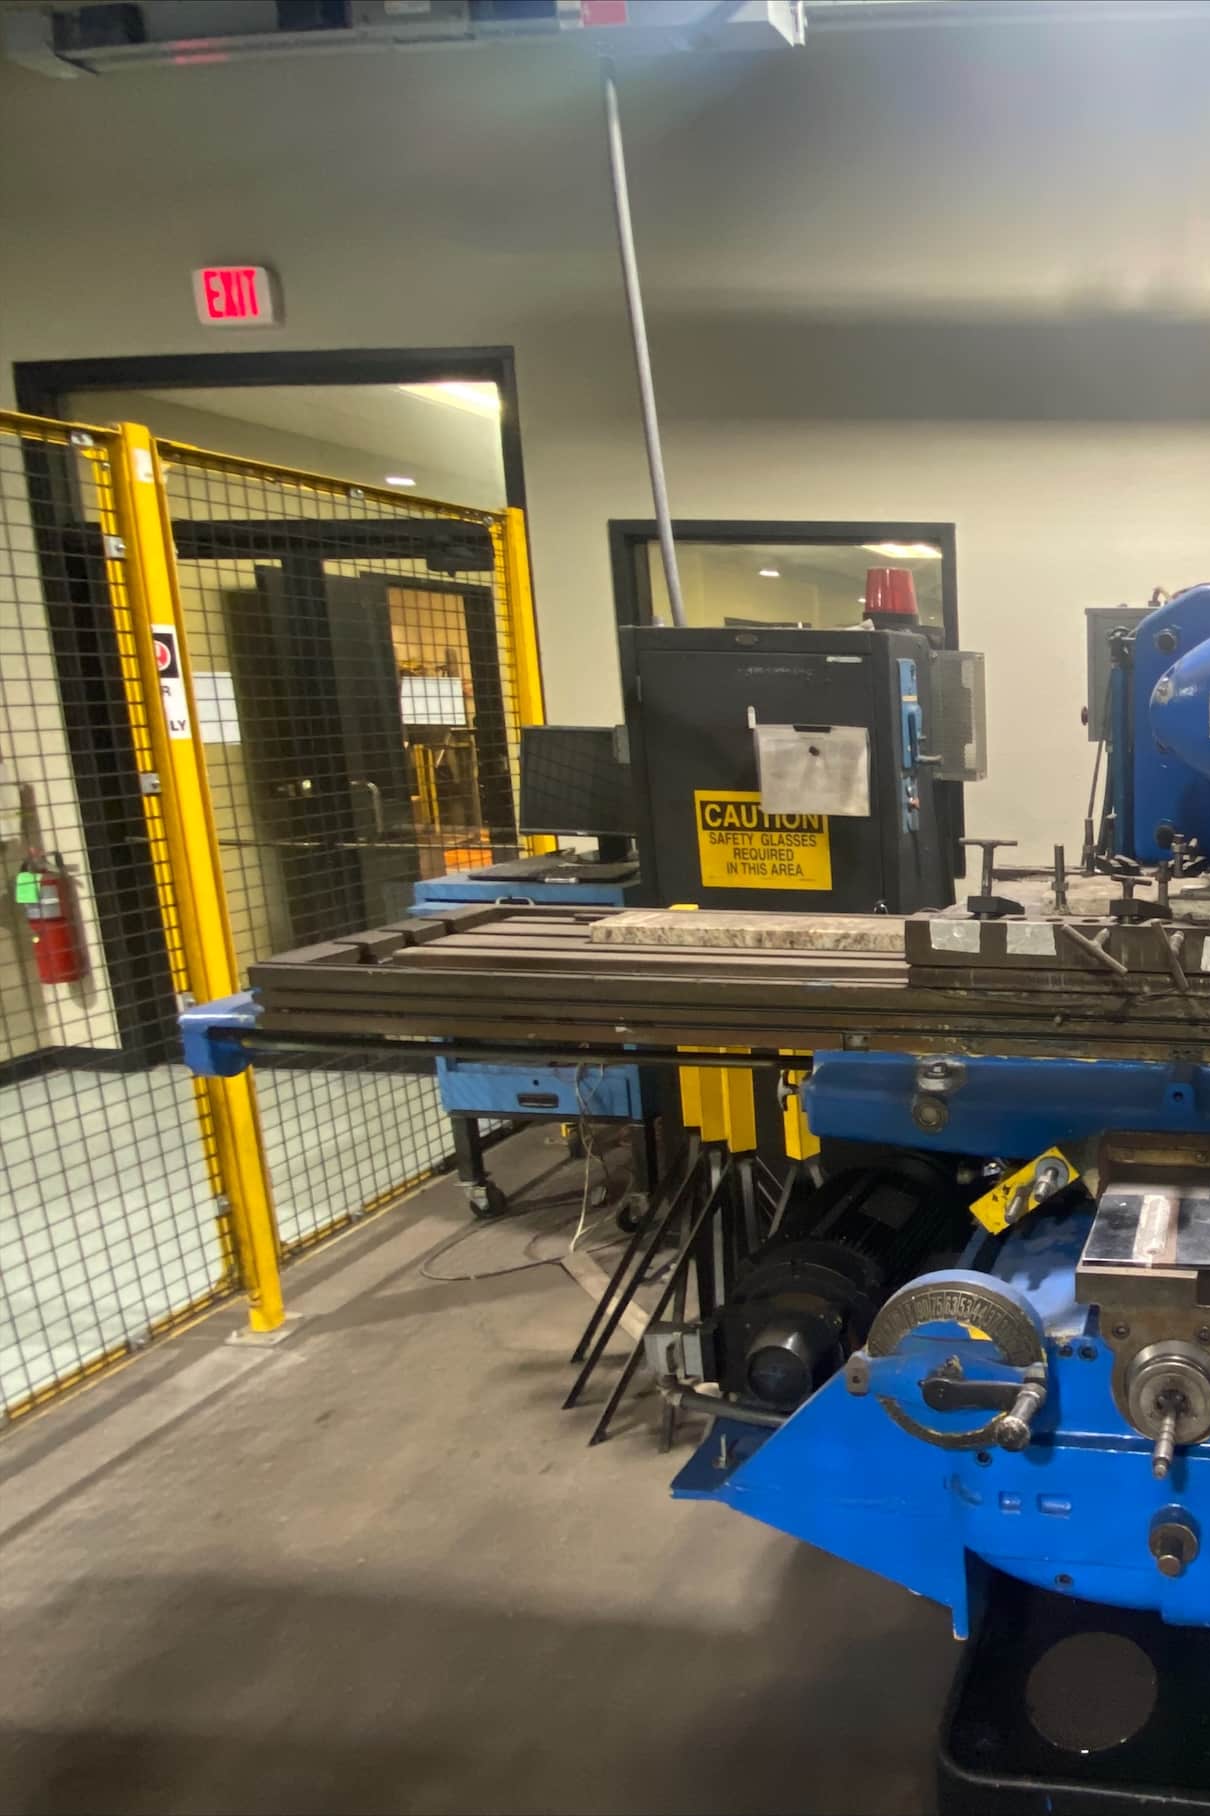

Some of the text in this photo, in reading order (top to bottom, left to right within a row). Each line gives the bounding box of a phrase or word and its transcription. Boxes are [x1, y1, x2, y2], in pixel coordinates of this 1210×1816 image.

[202, 268, 246, 306] EXIT
[704, 803, 819, 829] CAUTION
[709, 832, 817, 847] SAFETY GLASSES
[733, 847, 794, 861] REQUIRED
[726, 862, 804, 876] IN THIS AREA
[960, 1296, 973, 1316] 53
